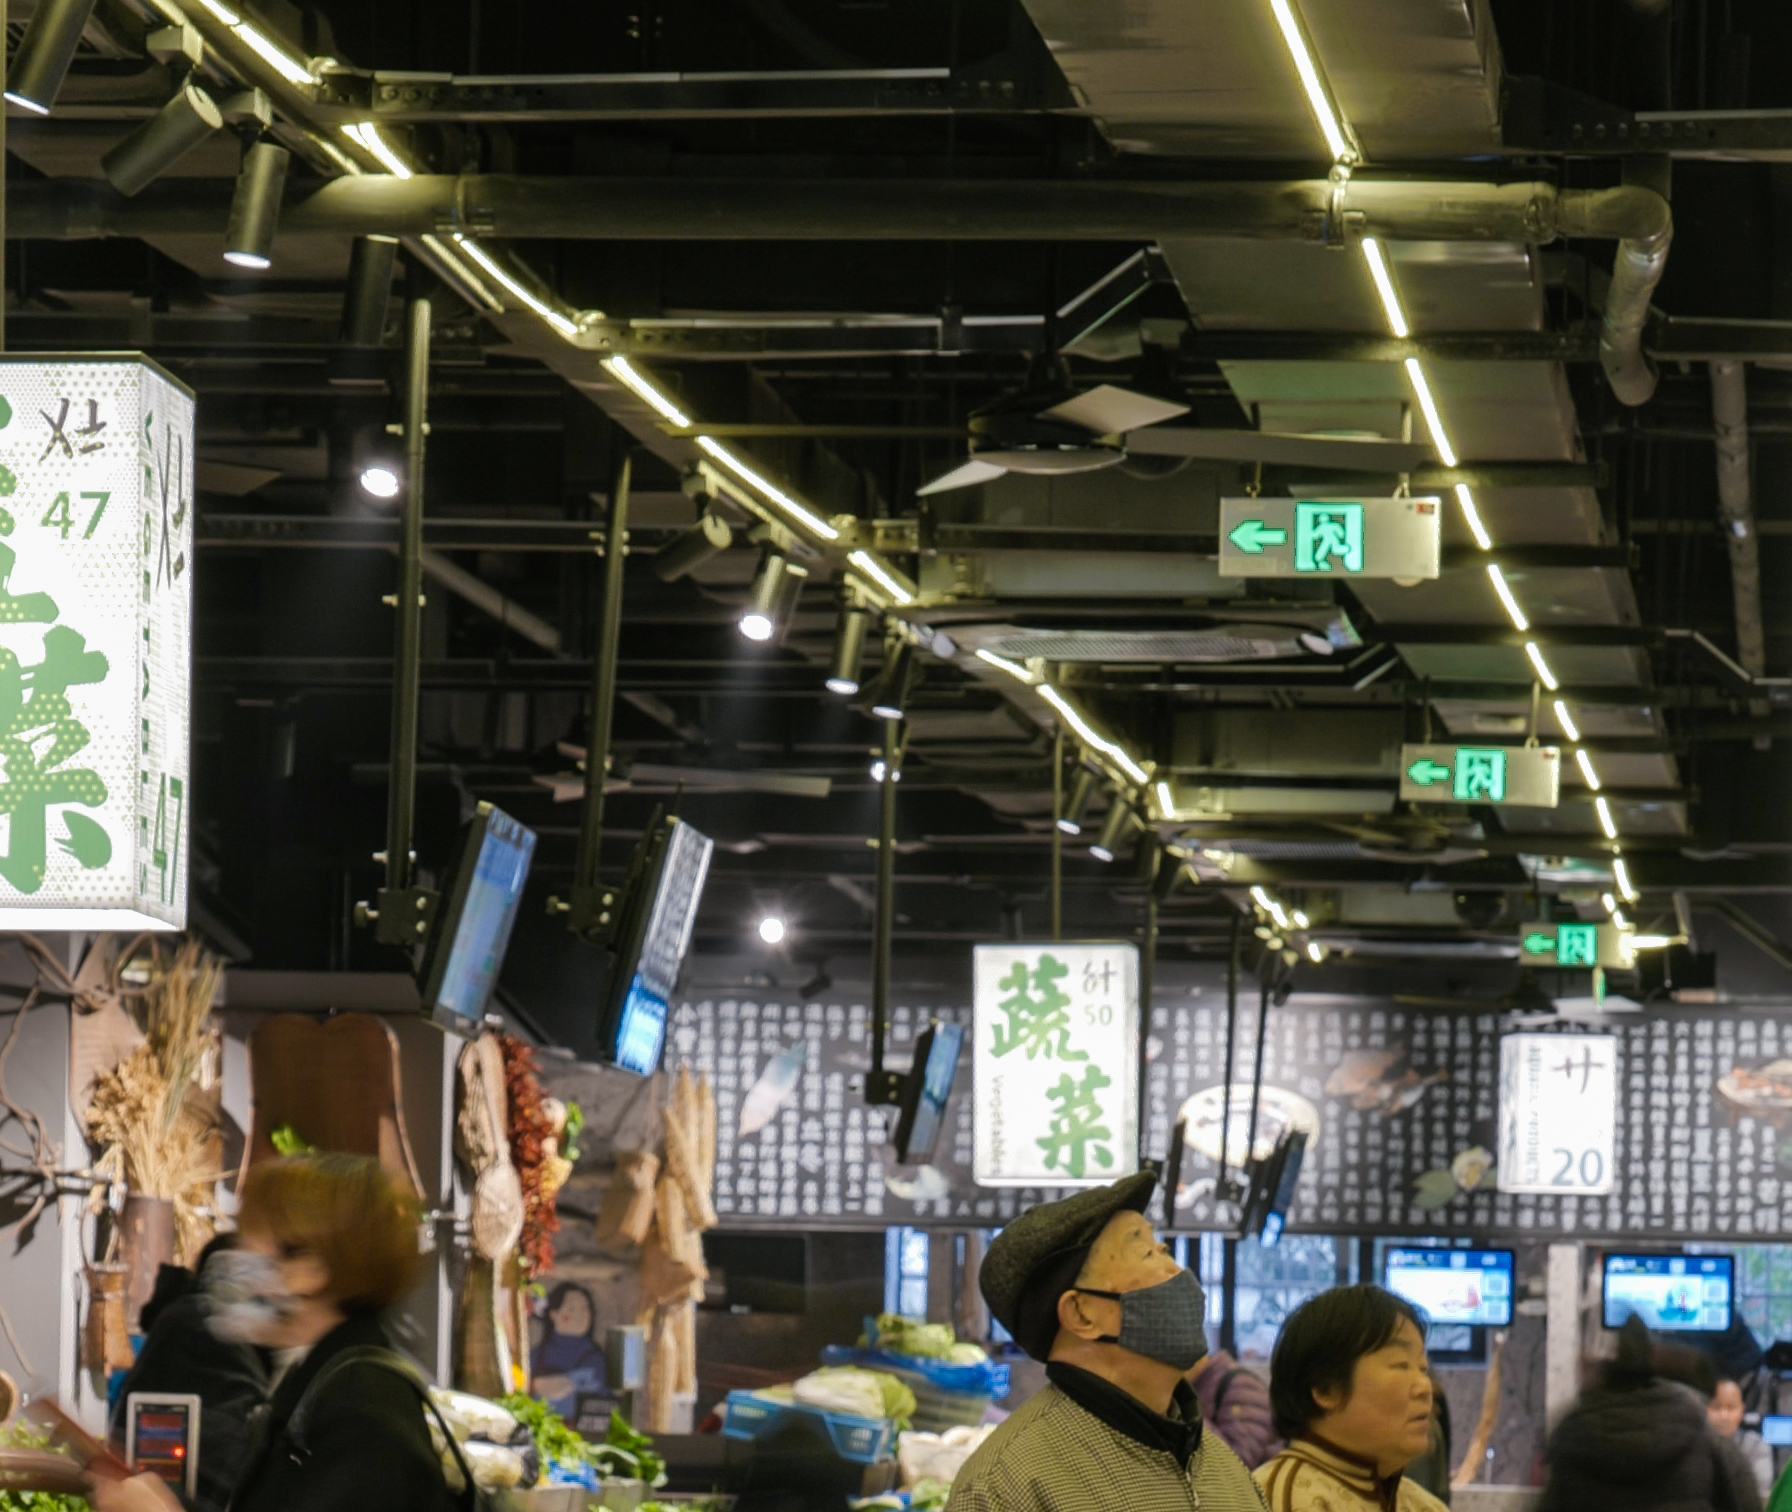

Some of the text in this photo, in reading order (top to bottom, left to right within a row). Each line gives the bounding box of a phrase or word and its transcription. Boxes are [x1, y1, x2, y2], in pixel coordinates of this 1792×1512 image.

[39, 490, 113, 541] 47
[1083, 1003, 1114, 1027] 50
[988, 953, 1113, 1179] 蔬菜
[1551, 1147, 1605, 1187] 20
